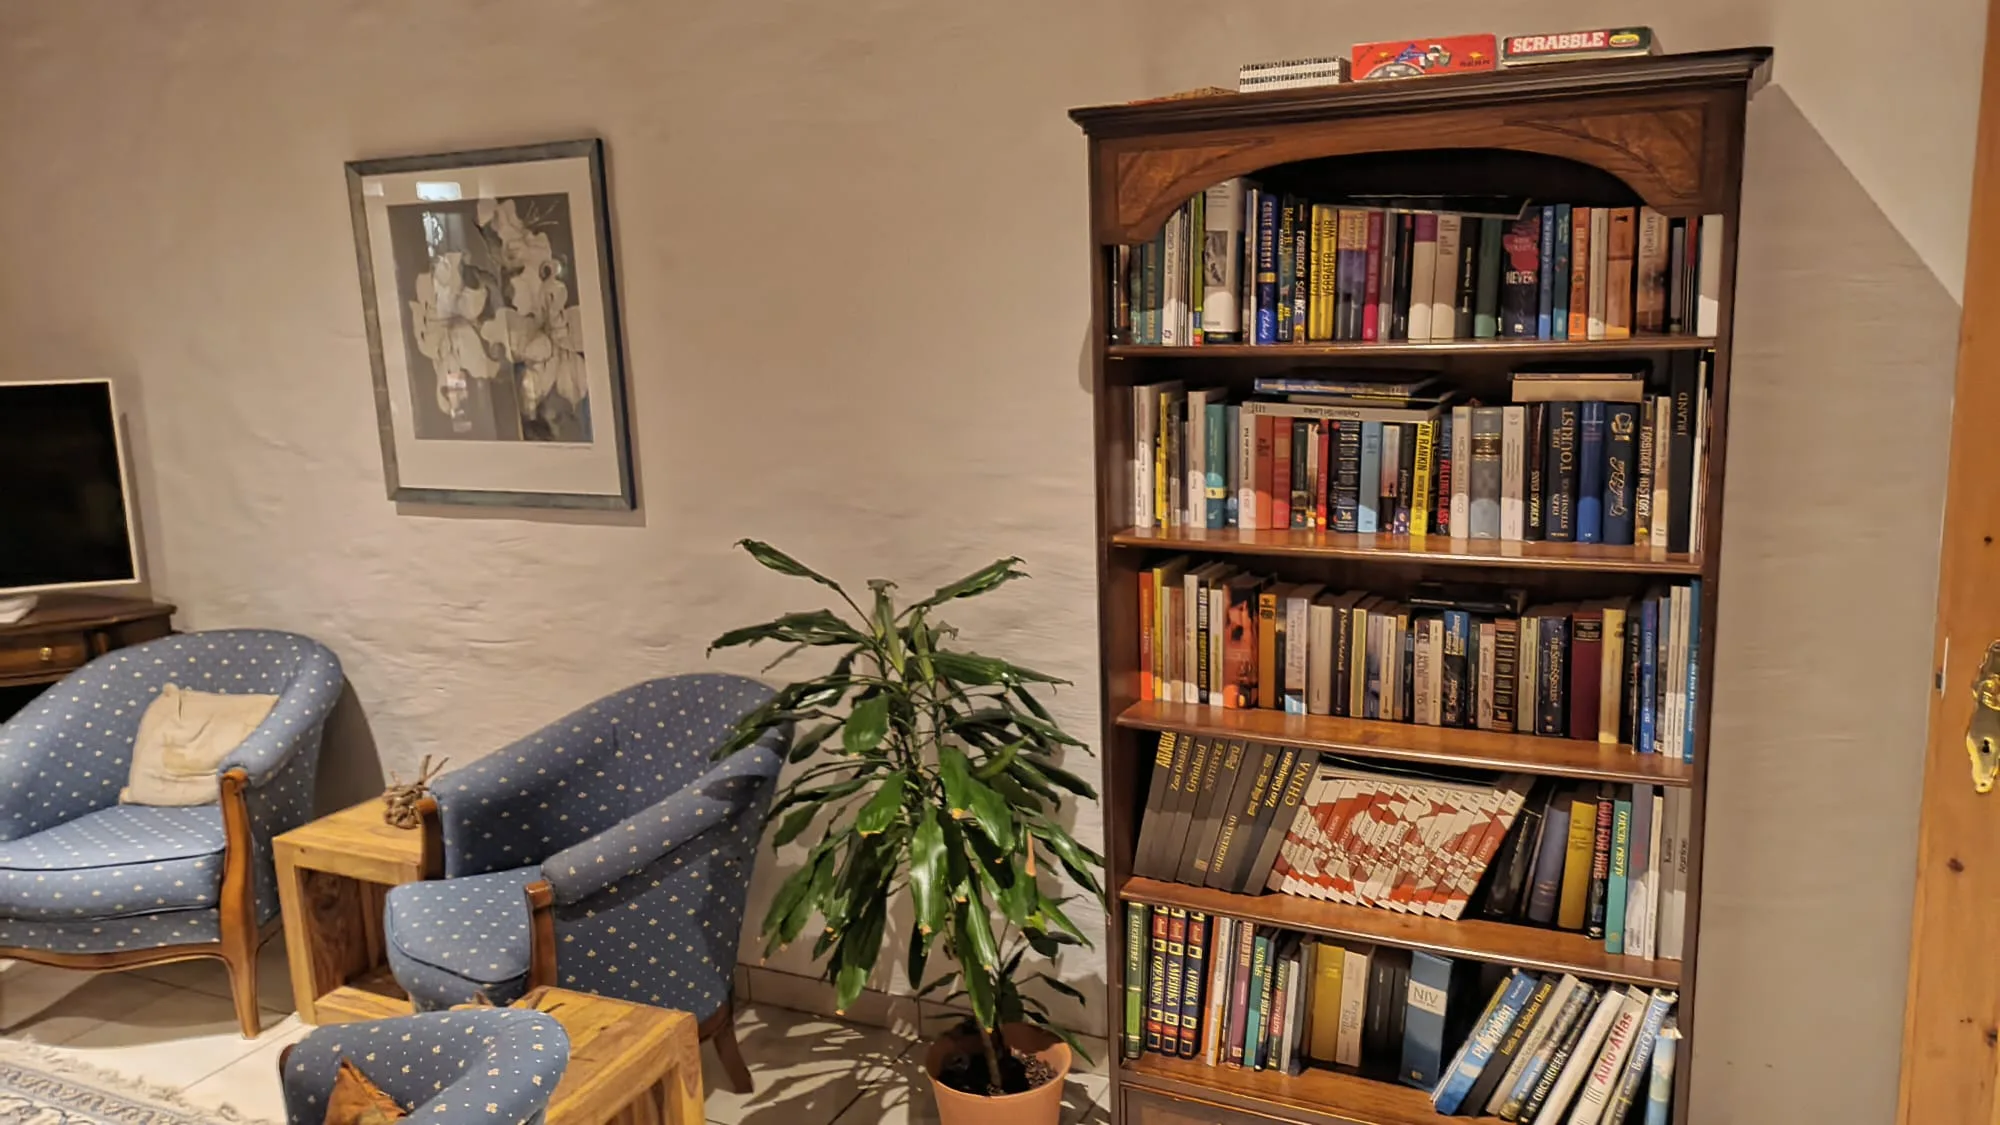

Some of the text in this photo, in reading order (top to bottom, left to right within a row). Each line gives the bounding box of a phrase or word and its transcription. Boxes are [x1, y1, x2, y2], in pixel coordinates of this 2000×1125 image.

[1512, 32, 1604, 53] SCRABBLE
[1283, 207, 1294, 235] Robert
[1295, 230, 1305, 316] FORBIDDEN SCIENCE
[1506, 271, 1537, 285] NEVER
[1677, 392, 1689, 436] IRLAND
[1418, 438, 1430, 471] RANKIN
[1552, 428, 1561, 448] DER
[1559, 407, 1574, 474] TOURIST
[1439, 459, 1451, 495] FALLING
[1638, 425, 1653, 517] FORBIDDEN HISTORY
[1438, 496, 1449, 524] GLASS
[1530, 493, 1540, 527] NICHOLAS
[1155, 731, 1176, 768] ARABIA
[1265, 791, 1278, 808] Zoo
[1285, 761, 1311, 807] CHINA
[1213, 815, 1238, 873] GRIECHENLAND
[1593, 801, 1612, 880] GUN FOR HIRE
[1614, 847, 1625, 877] ALASKA
[1152, 955, 1163, 1005] OZEANIEN
[1167, 960, 1181, 1007] AMERIKA
[1184, 967, 1199, 1006] AFRIKA
[1414, 987, 1439, 1005] NIV
[1593, 1011, 1634, 1086] Auto-Atlas
[1533, 1049, 1569, 1102] ORCHIDEEN
